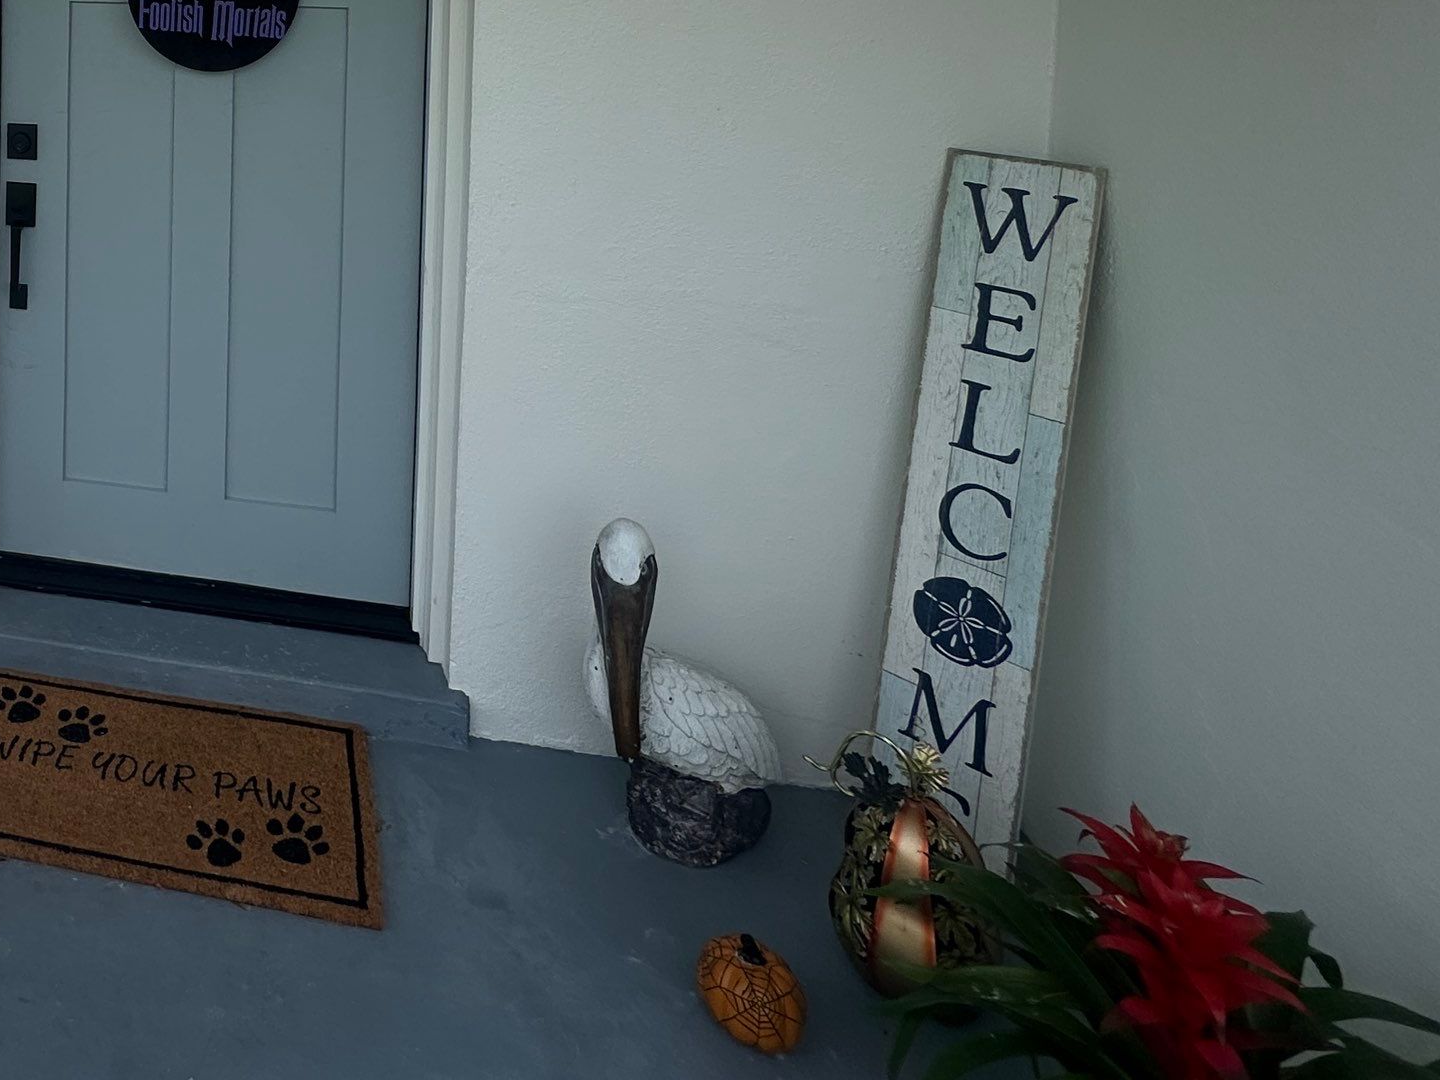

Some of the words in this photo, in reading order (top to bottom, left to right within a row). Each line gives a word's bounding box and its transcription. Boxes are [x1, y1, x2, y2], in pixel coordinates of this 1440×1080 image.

[211, 0, 288, 48] Mortals
[92, 750, 196, 794] YOUR
[213, 771, 322, 816] PAWS
